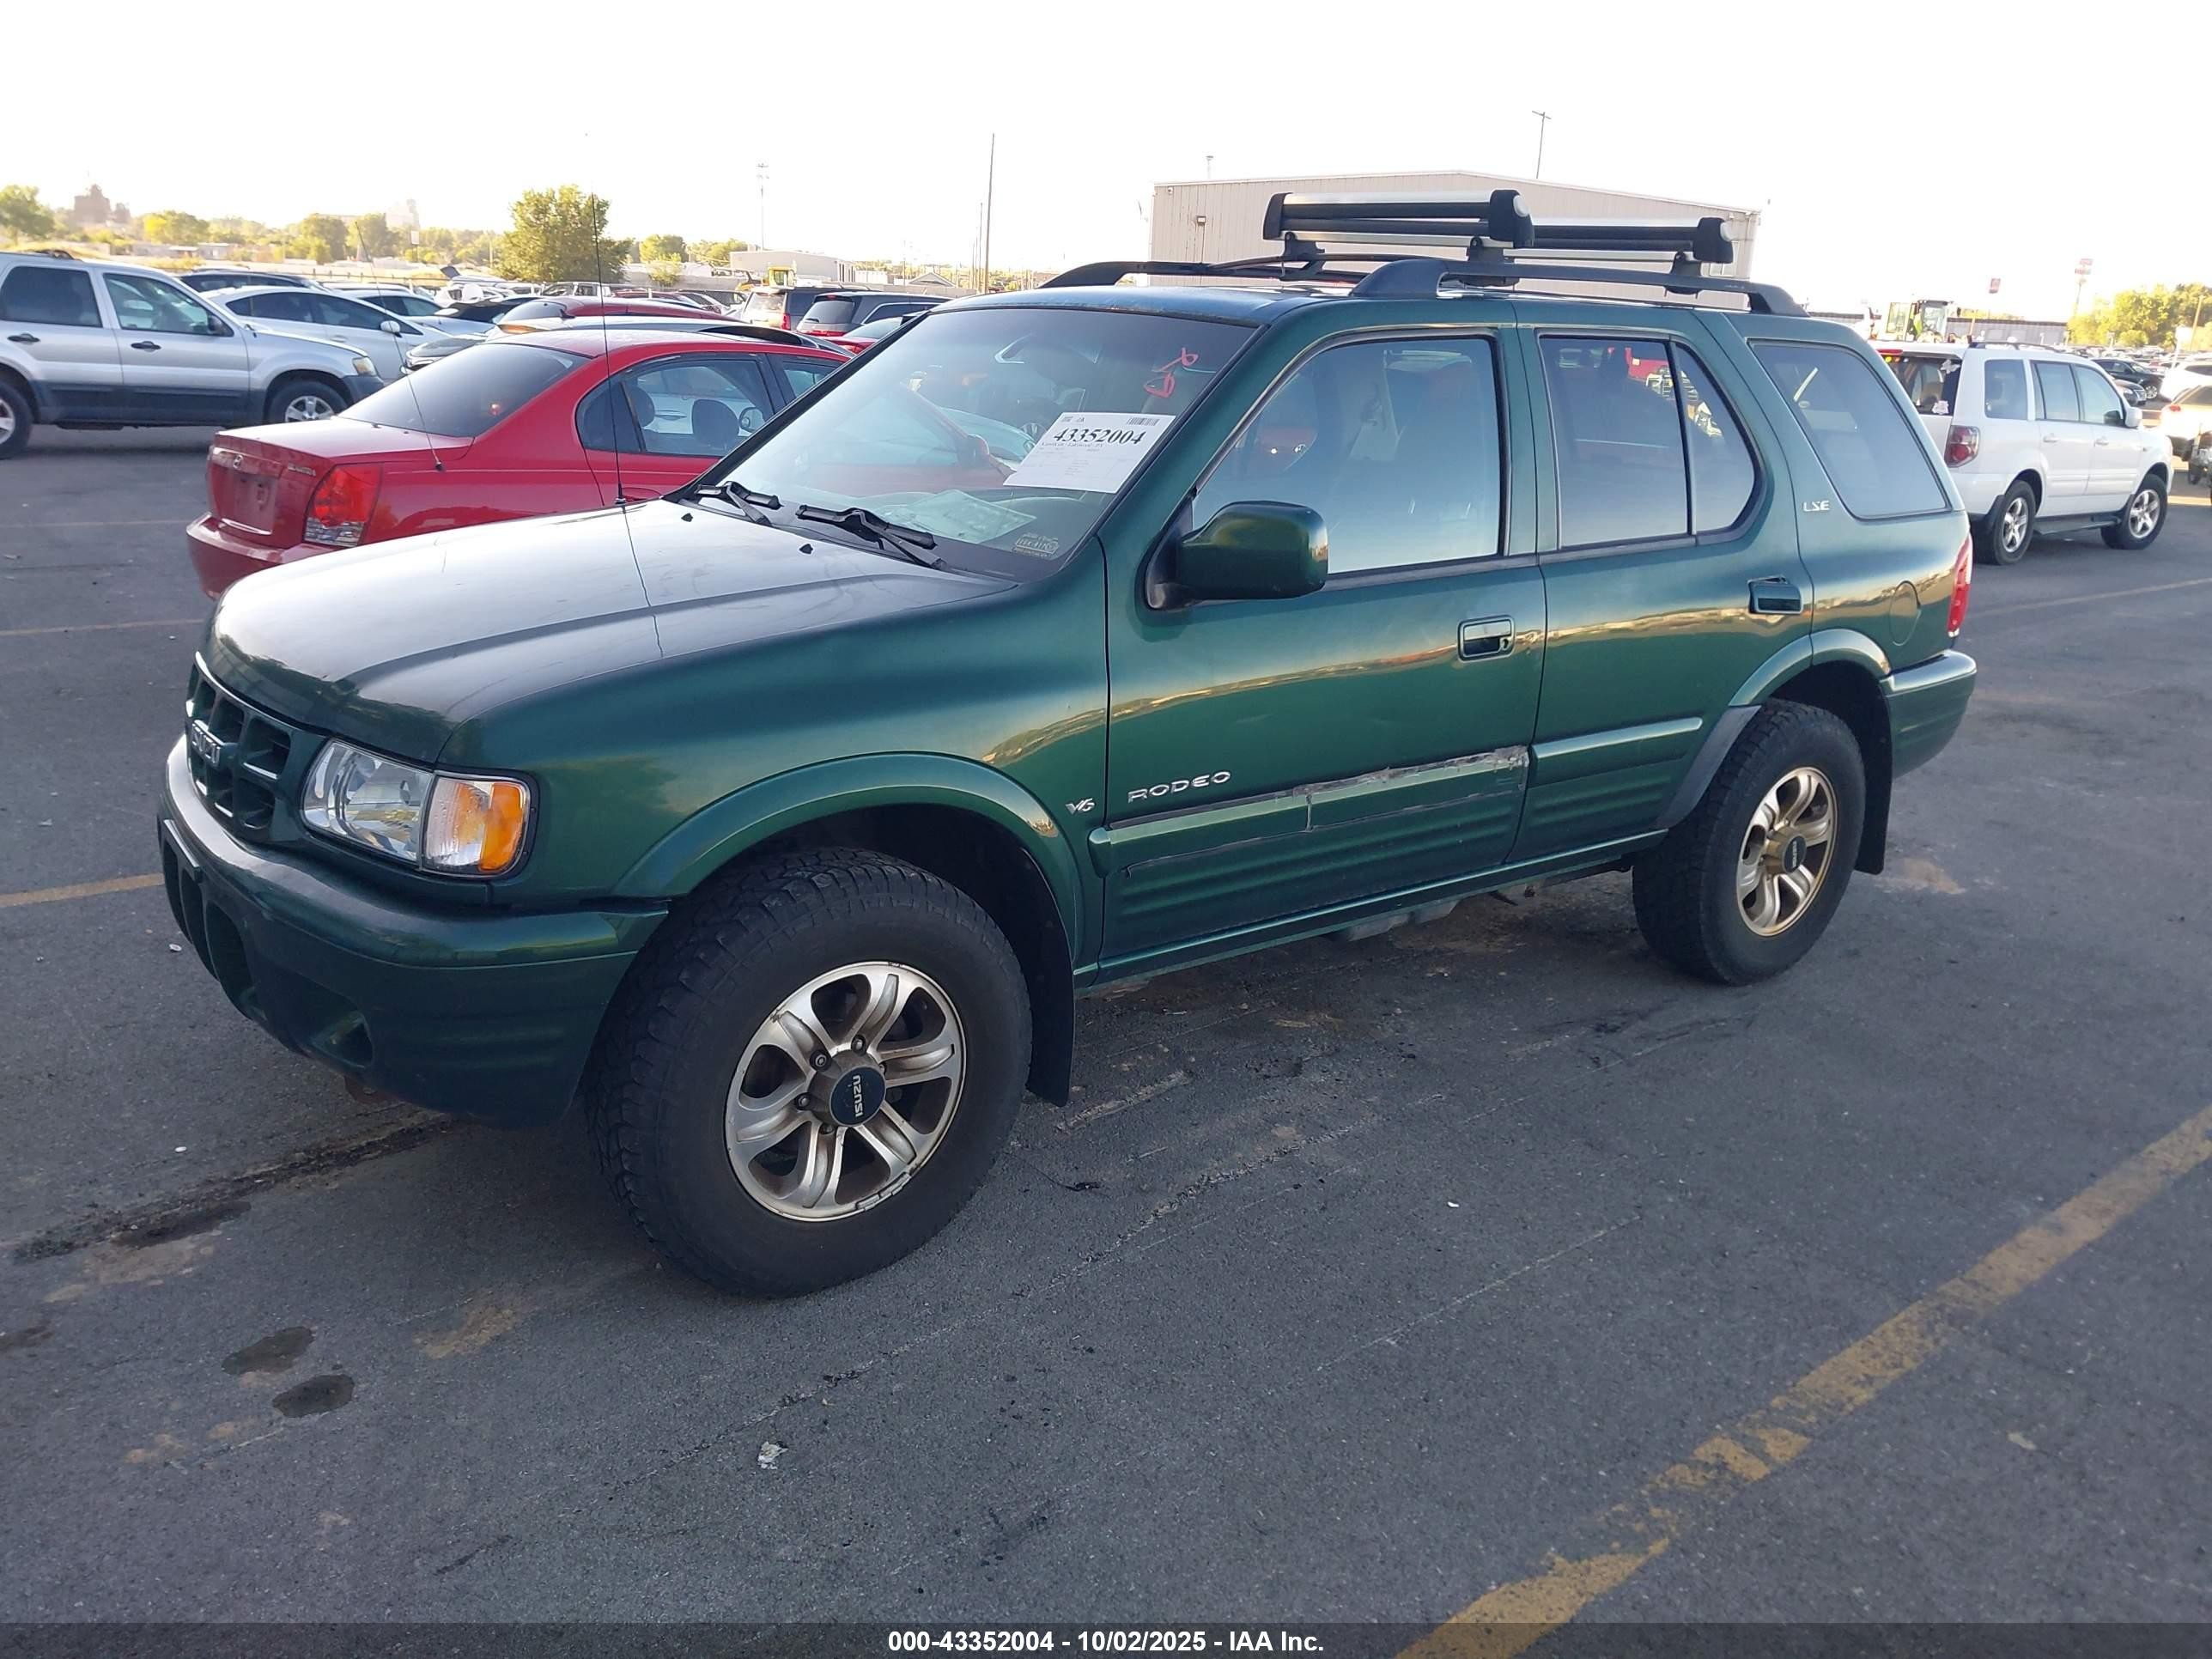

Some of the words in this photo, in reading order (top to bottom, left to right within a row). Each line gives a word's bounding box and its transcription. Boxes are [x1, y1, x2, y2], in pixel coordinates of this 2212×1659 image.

[1053, 428, 1146, 444] 43352004
[1803, 500, 1830, 512] LSE
[1127, 771, 1231, 804] RODEO
[1065, 798, 1096, 815] V6
[853, 1074, 864, 1117] ISUZU
